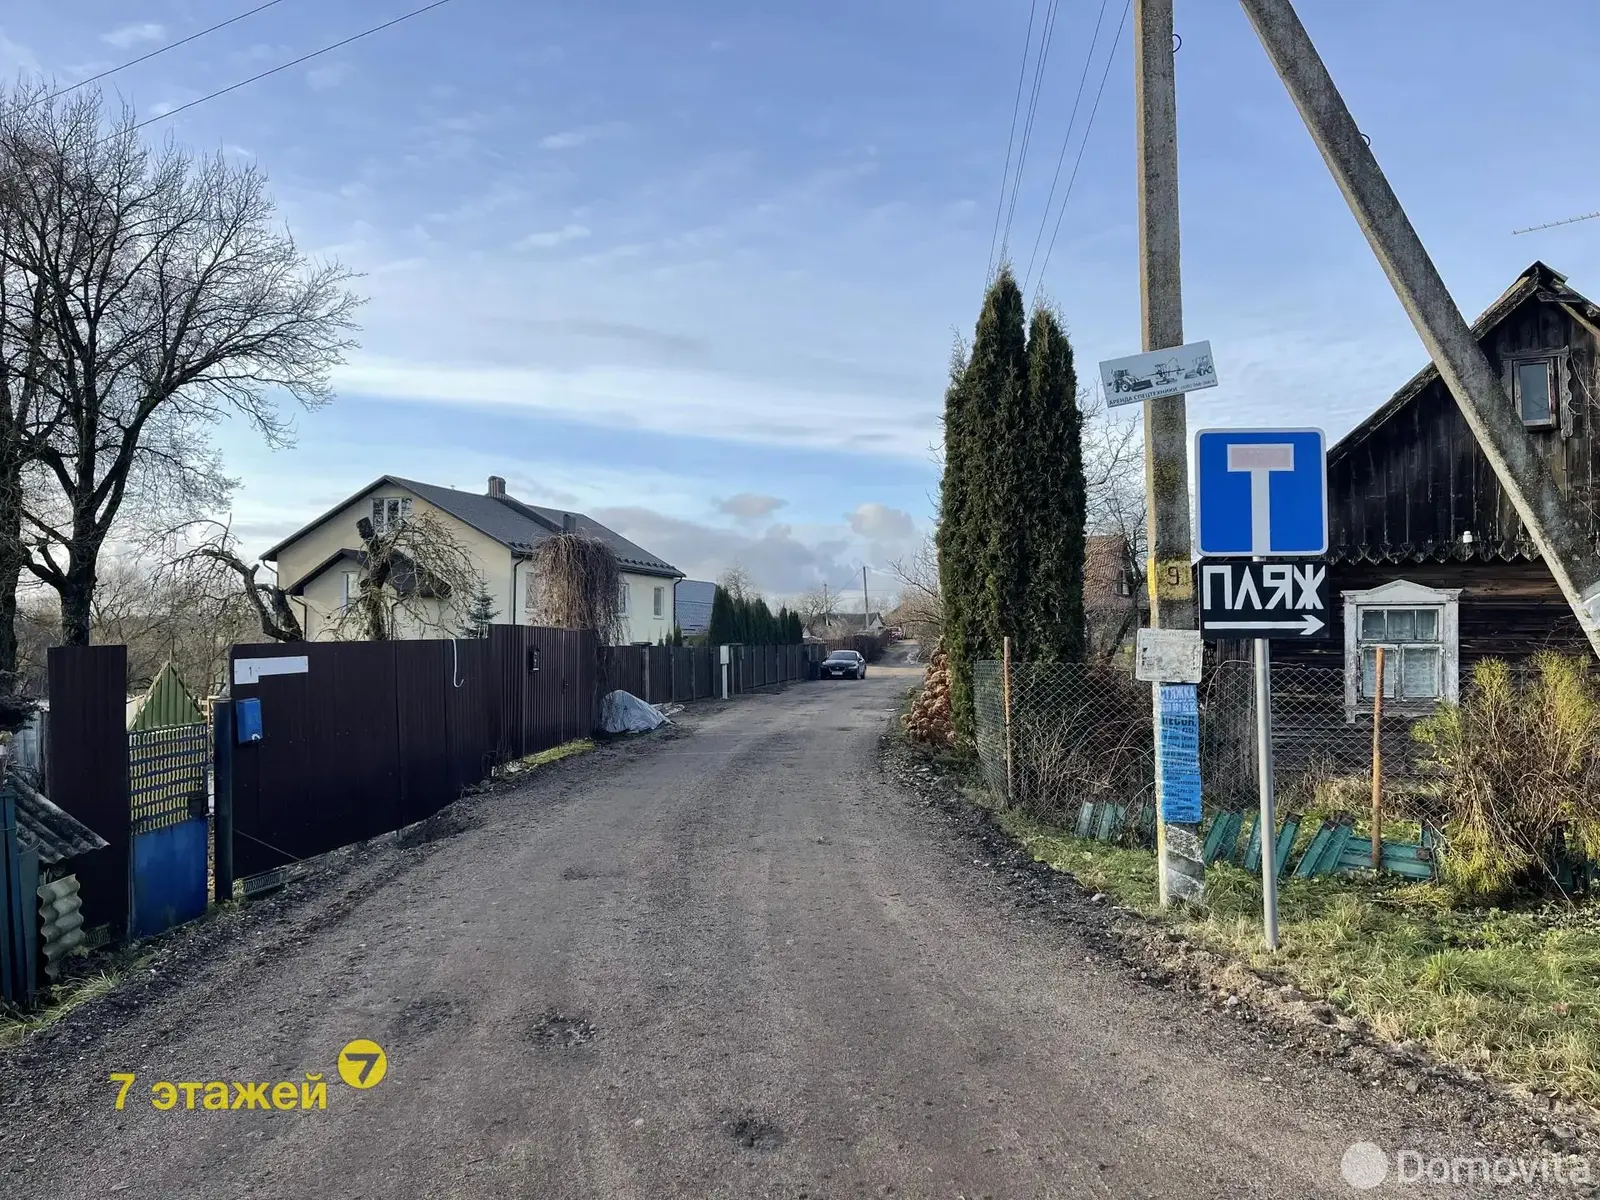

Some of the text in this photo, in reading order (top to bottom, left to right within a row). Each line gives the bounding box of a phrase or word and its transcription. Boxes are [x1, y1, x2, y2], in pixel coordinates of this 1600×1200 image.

[1109, 387, 1178, 406] АРЕНДА СПЕЦТЕХНИКИ
[1166, 566, 1180, 586] 9
[1202, 564, 1326, 610] ПЛЯЖ
